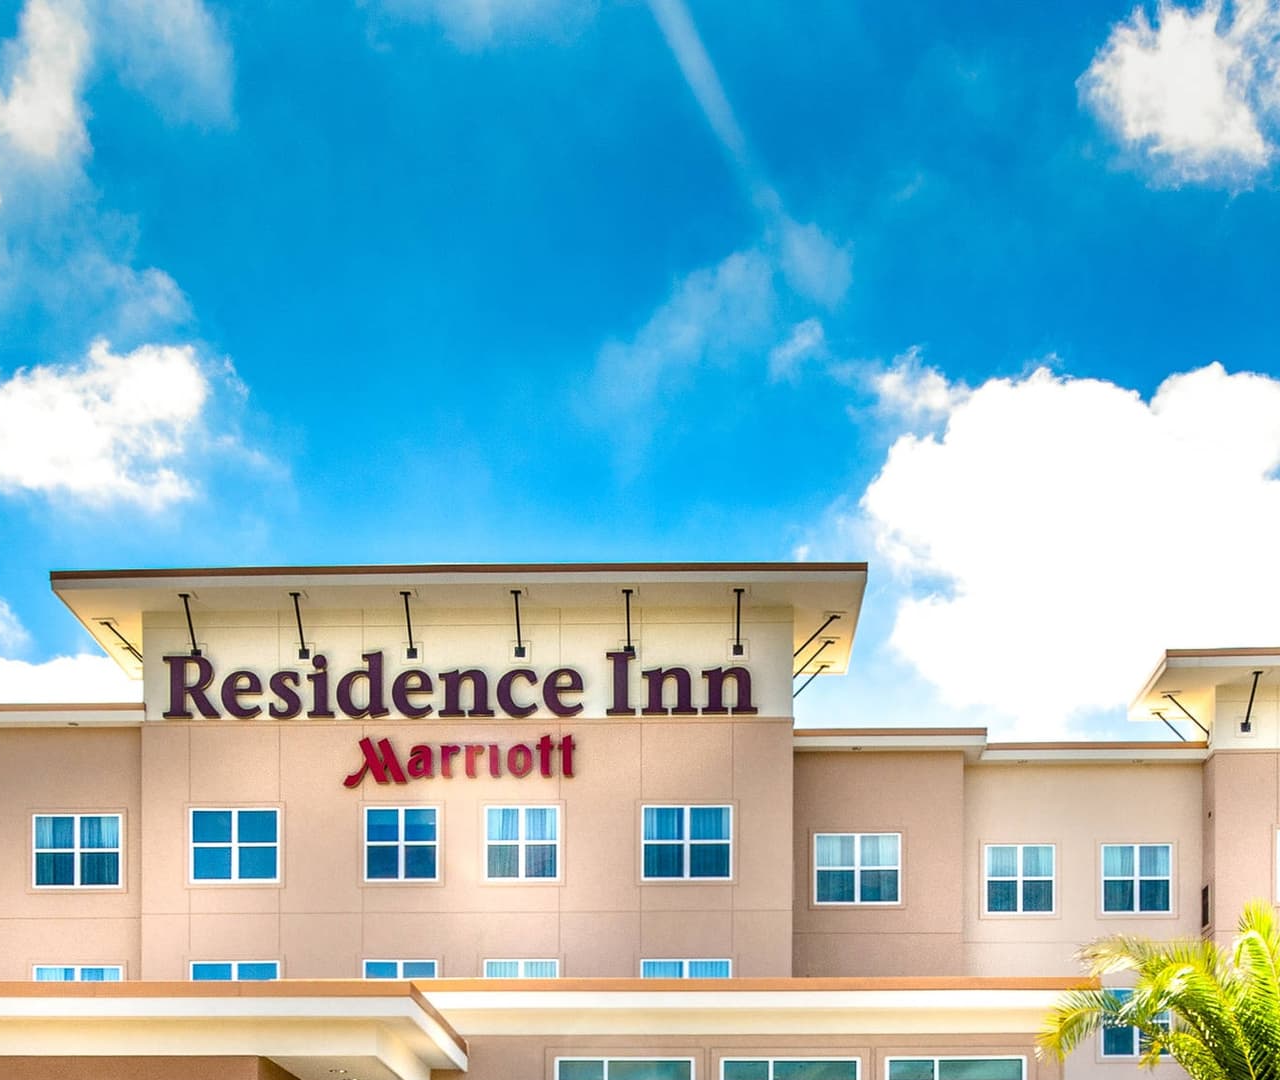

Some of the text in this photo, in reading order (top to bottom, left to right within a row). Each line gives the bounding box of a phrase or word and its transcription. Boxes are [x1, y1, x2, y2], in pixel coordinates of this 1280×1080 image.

[162, 650, 759, 720] Residence Inn
[342, 734, 576, 788] Marriott
